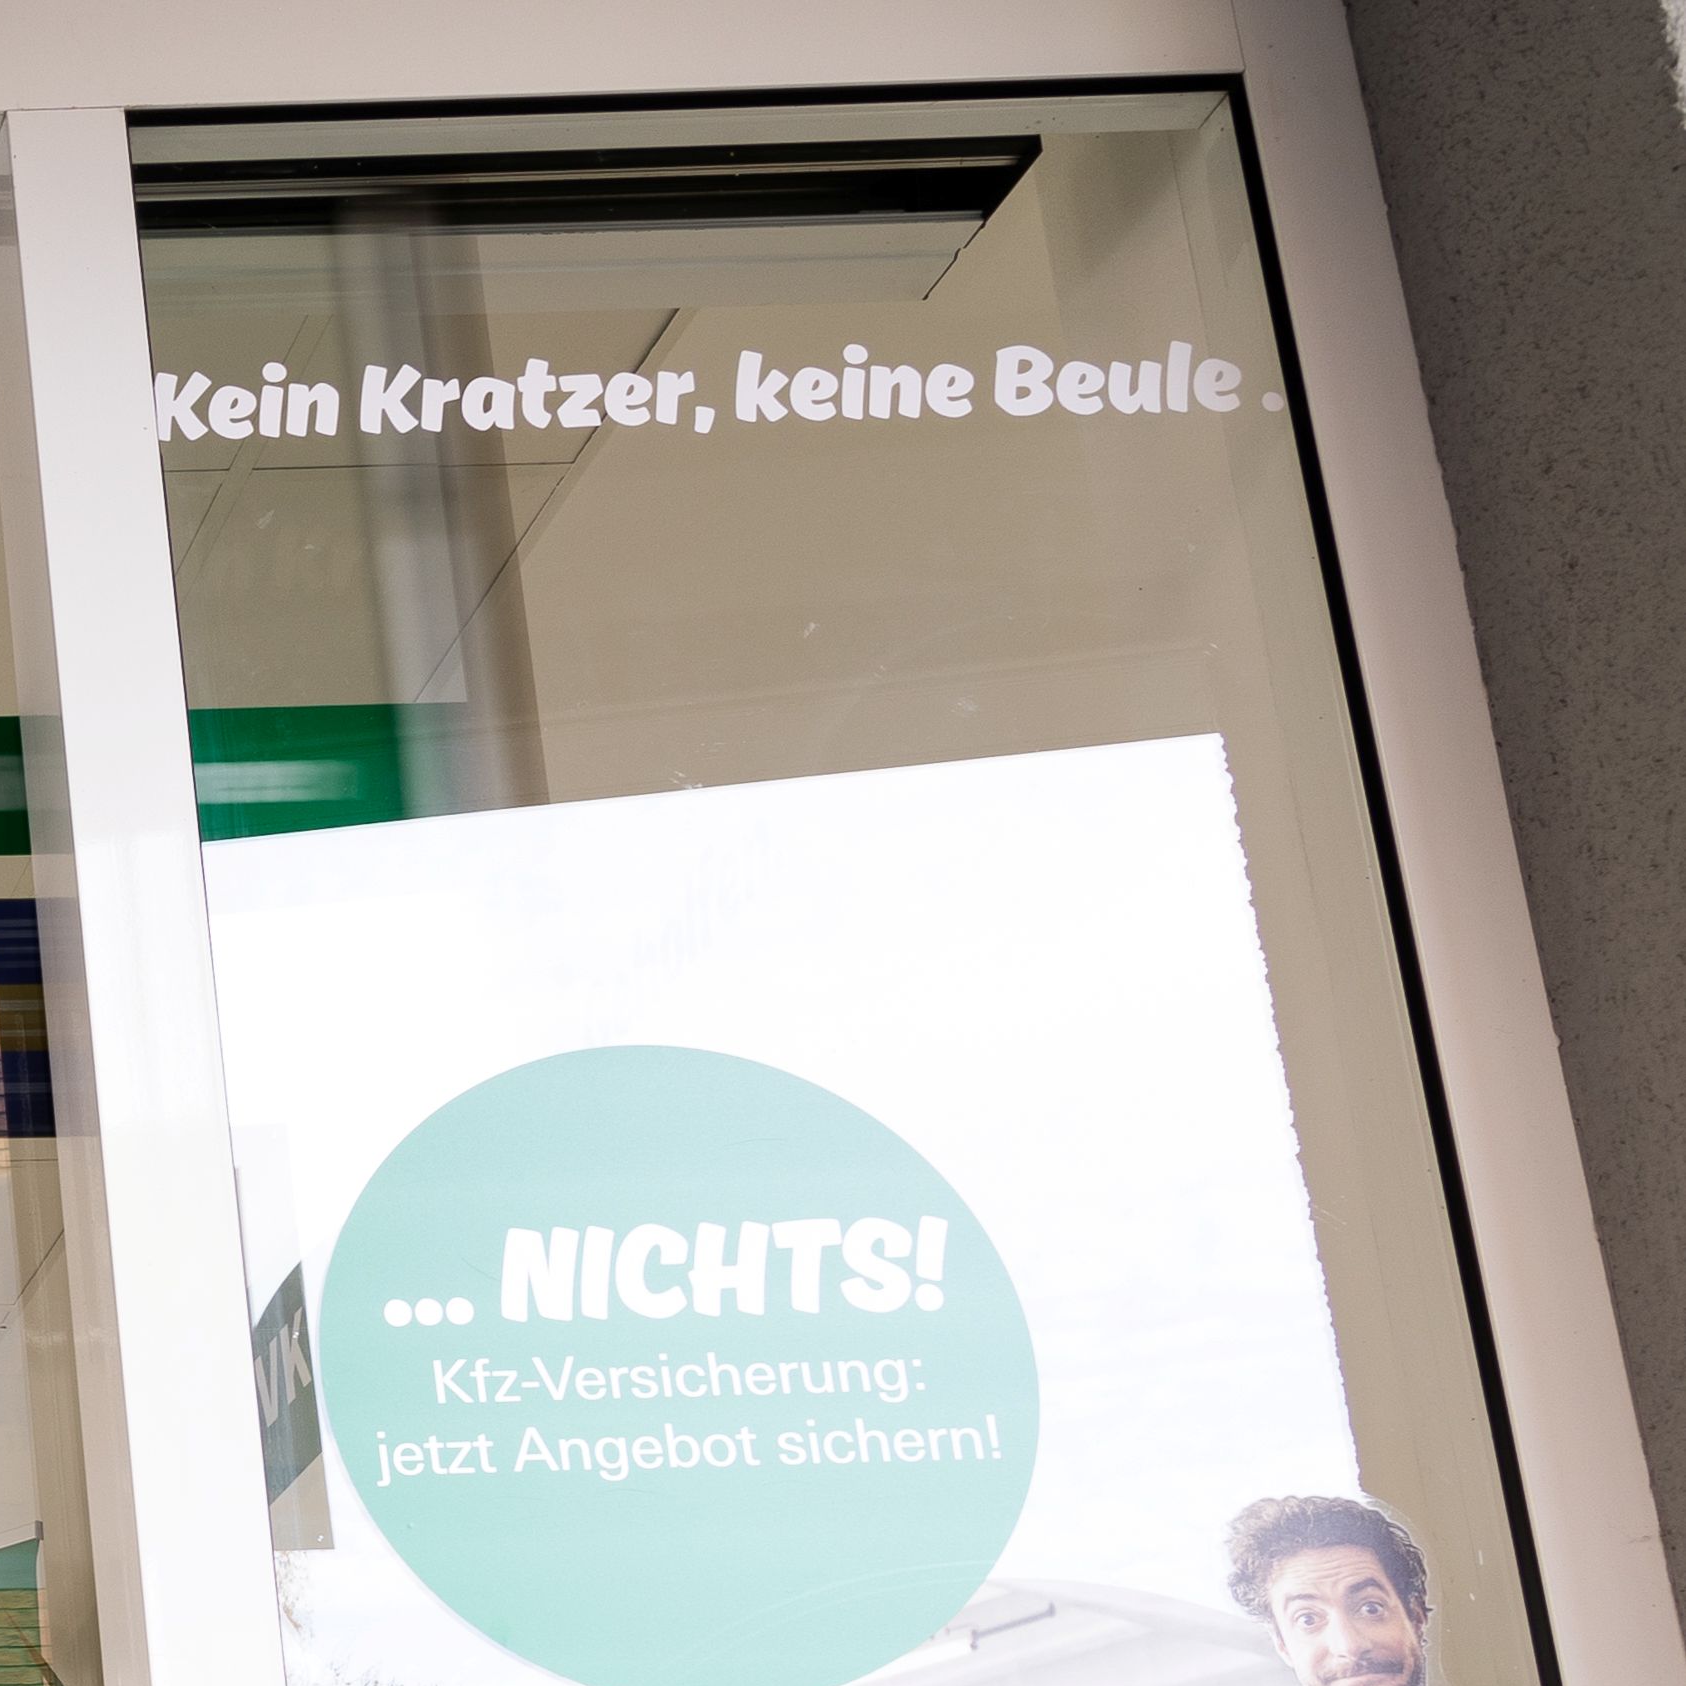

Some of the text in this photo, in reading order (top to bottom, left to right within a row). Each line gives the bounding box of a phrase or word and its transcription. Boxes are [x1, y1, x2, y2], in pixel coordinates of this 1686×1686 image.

[154, 361, 340, 442] Kein
[359, 357, 716, 435] Kratzer,
[735, 343, 975, 422] keine
[499, 1215, 950, 1323] NICHTS!
[432, 1350, 927, 1407] Kfz-Versicherung:
[375, 1414, 1003, 1487] jetzt Angebot sichern!
